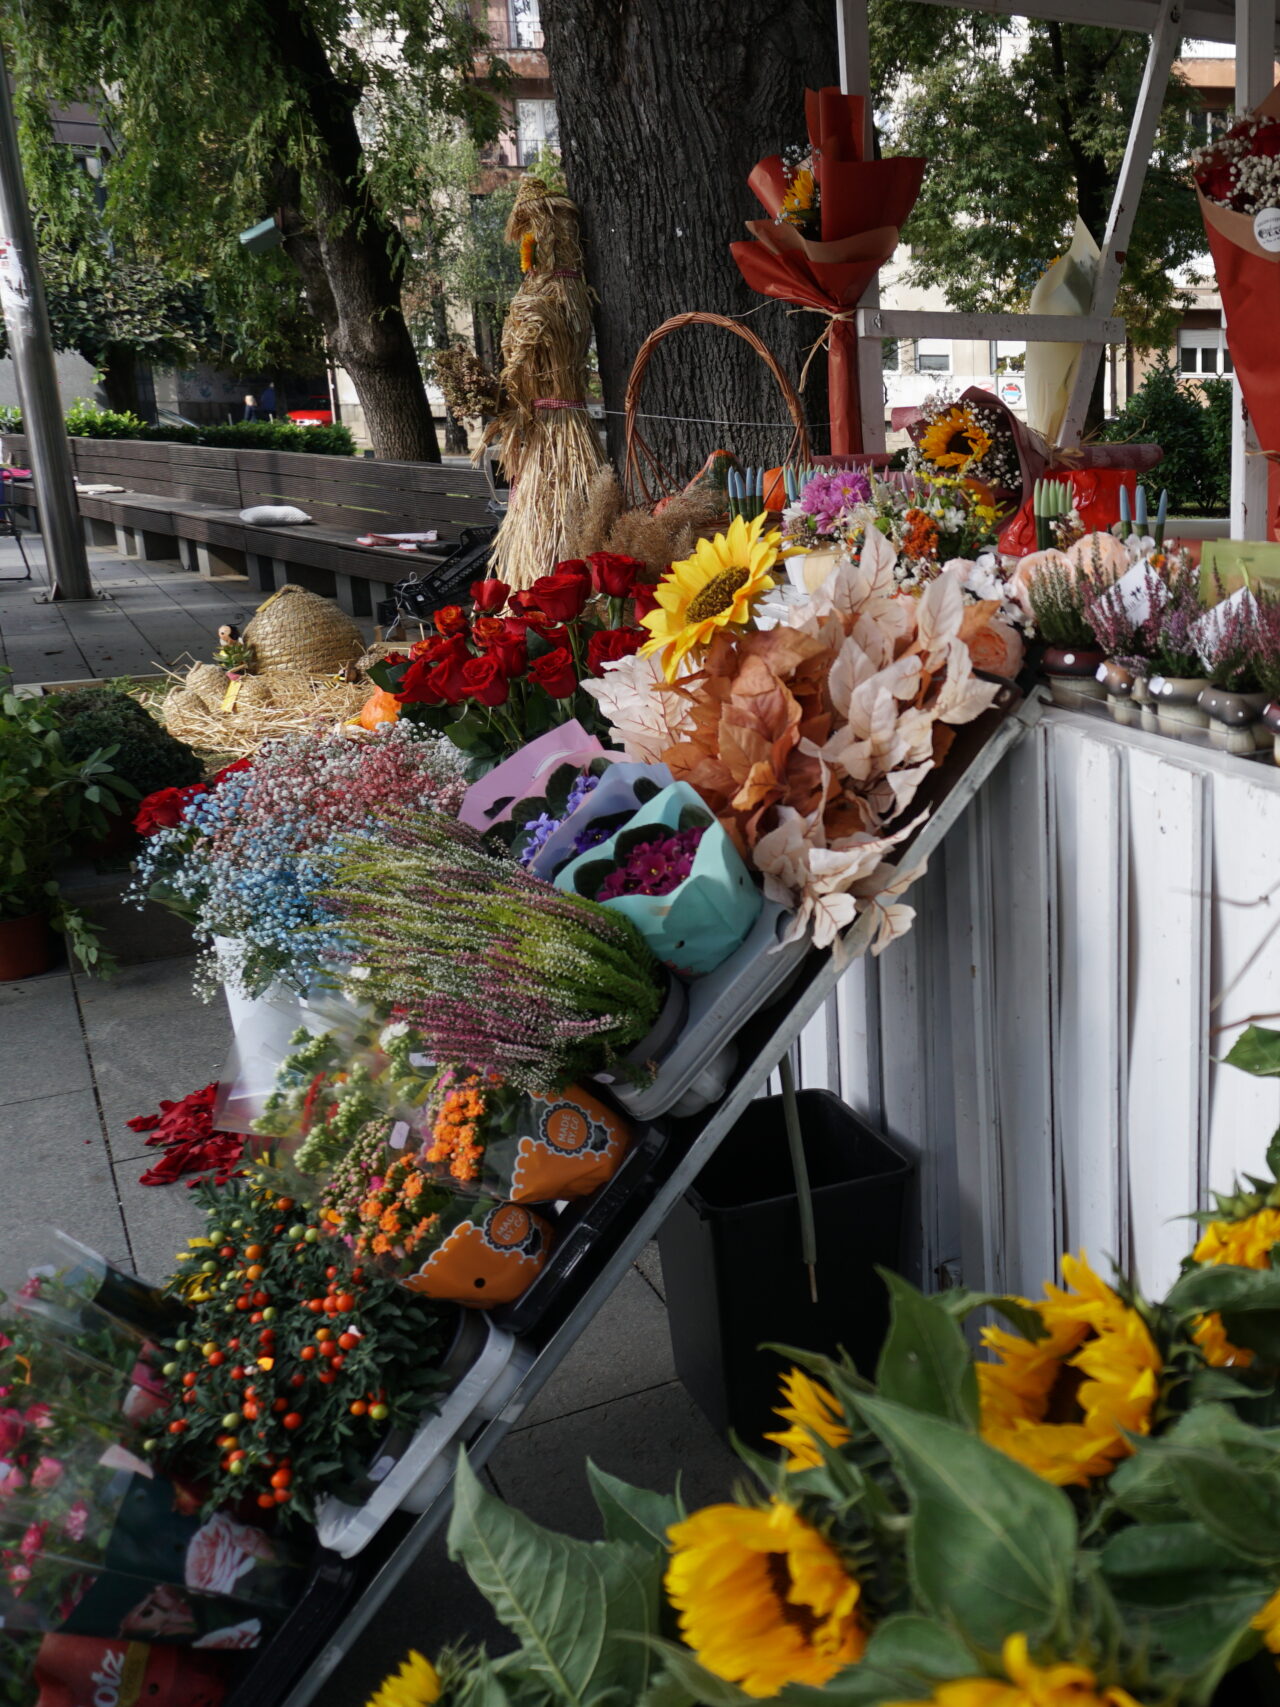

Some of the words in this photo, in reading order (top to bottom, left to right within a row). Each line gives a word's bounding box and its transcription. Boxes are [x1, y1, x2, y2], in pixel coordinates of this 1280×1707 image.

[558, 1114, 571, 1142] MADE
[496, 1210, 517, 1235] MADE
[91, 1649, 124, 1707] otz
